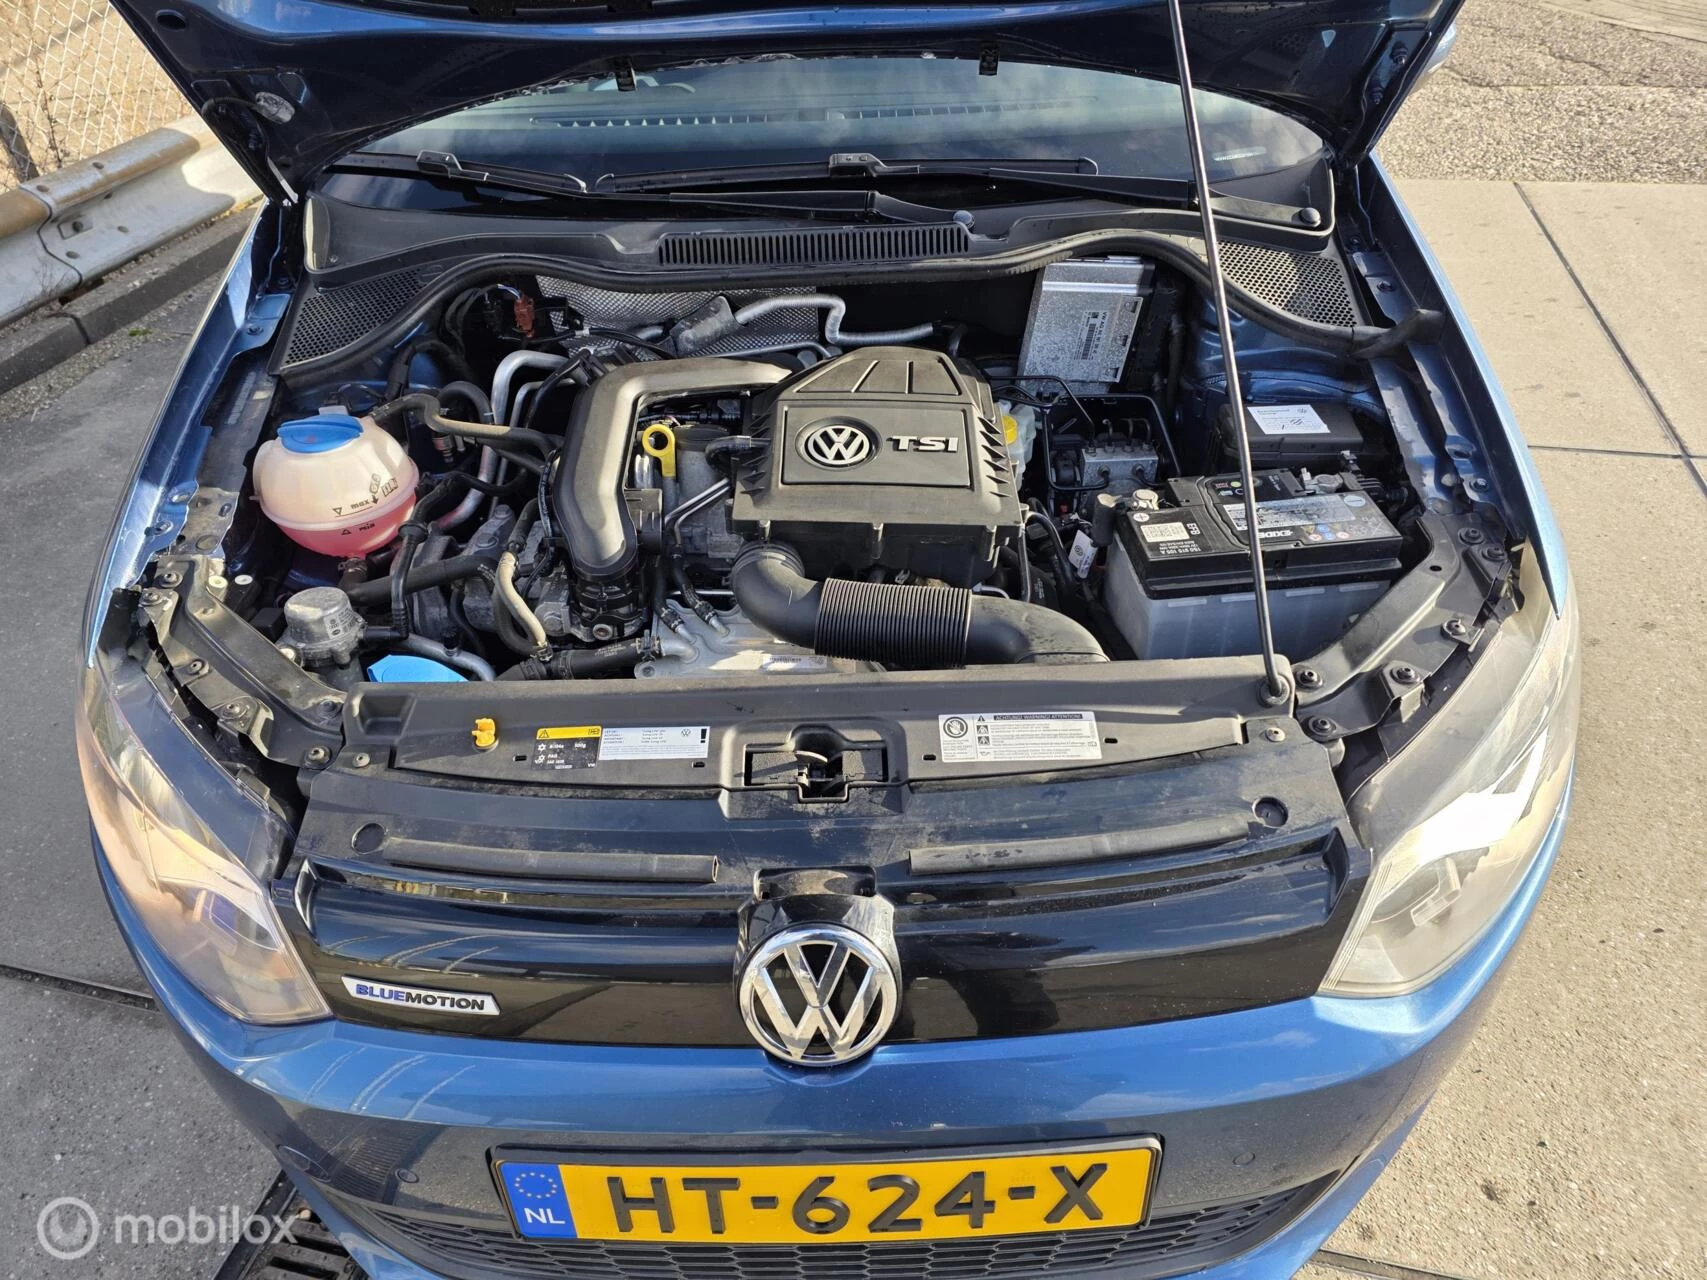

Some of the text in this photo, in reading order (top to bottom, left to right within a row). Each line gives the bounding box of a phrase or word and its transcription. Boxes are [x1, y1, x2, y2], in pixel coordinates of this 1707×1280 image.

[892, 435, 959, 452] TSI
[350, 499, 370, 510] max
[1186, 522, 1201, 536] EFB
[355, 983, 486, 1011] BLUEMOTION
[606, 1162, 1108, 1235] HT-624-X
[523, 1207, 566, 1225] NL
